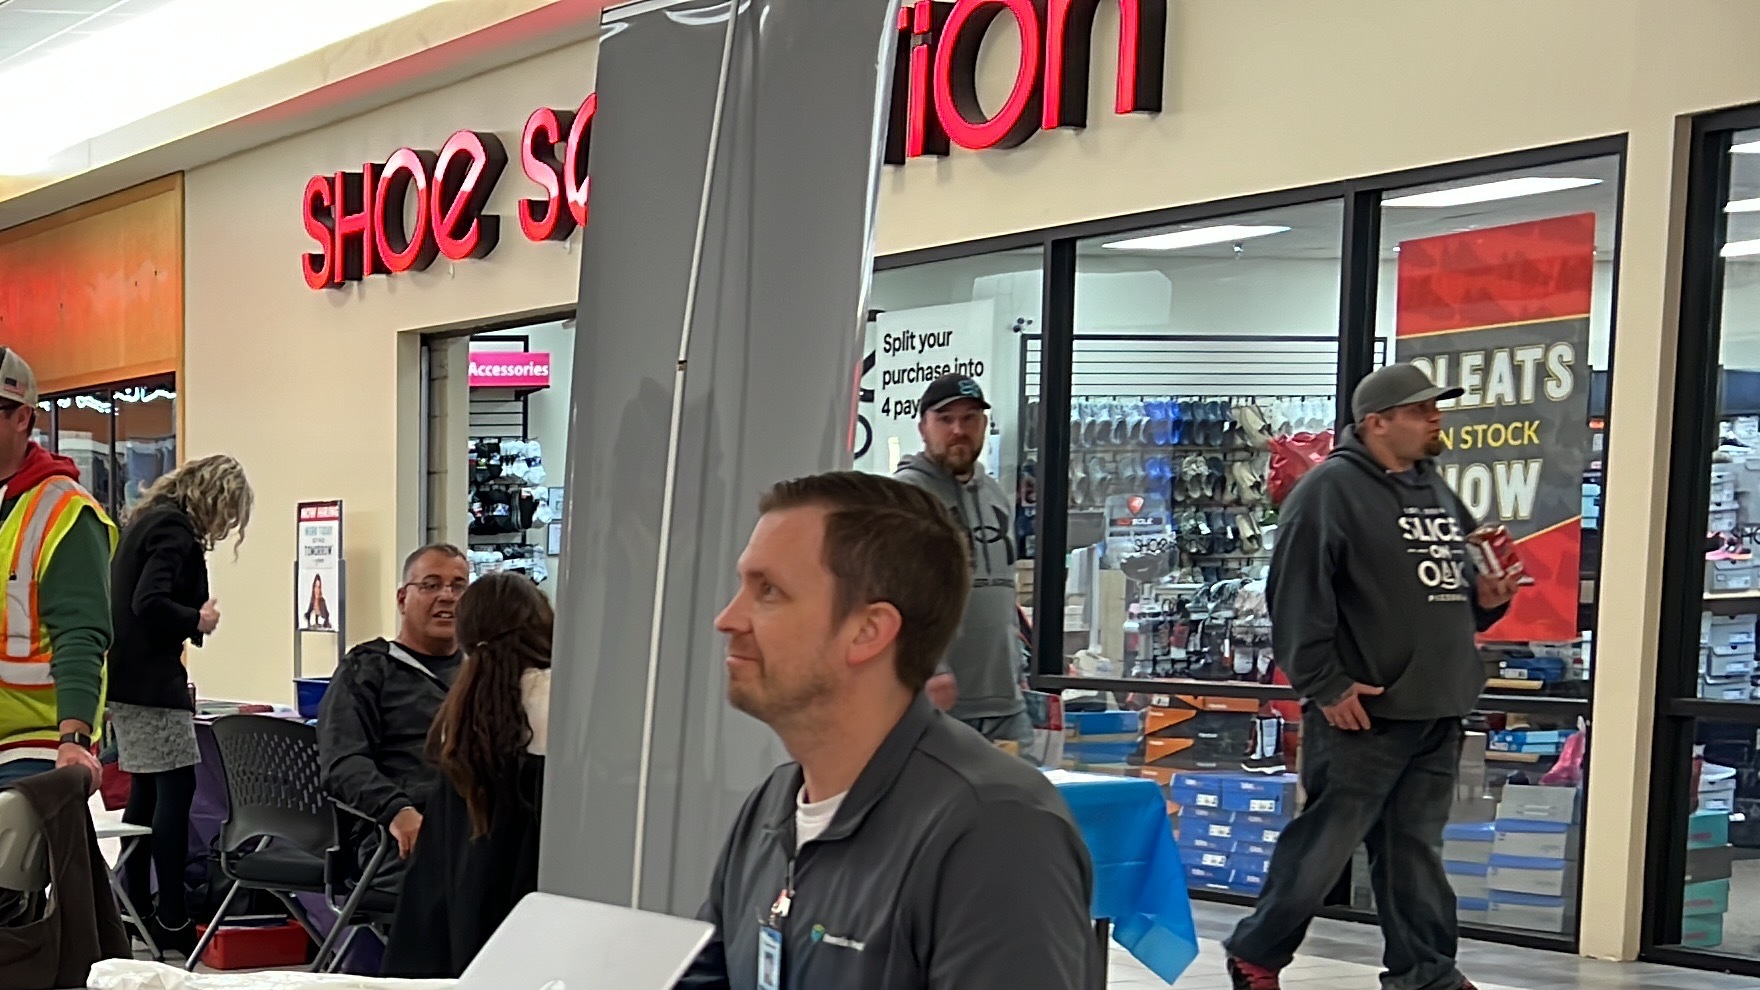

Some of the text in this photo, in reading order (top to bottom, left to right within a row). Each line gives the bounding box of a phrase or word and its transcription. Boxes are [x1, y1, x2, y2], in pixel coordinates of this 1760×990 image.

[883, 329, 953, 357] Split your
[468, 361, 549, 377] Accessories
[882, 357, 984, 390] purchase into
[881, 397, 921, 420] 4 pay
[1438, 420, 1541, 450] N STOCK
[1398, 516, 1465, 542] SLICE
